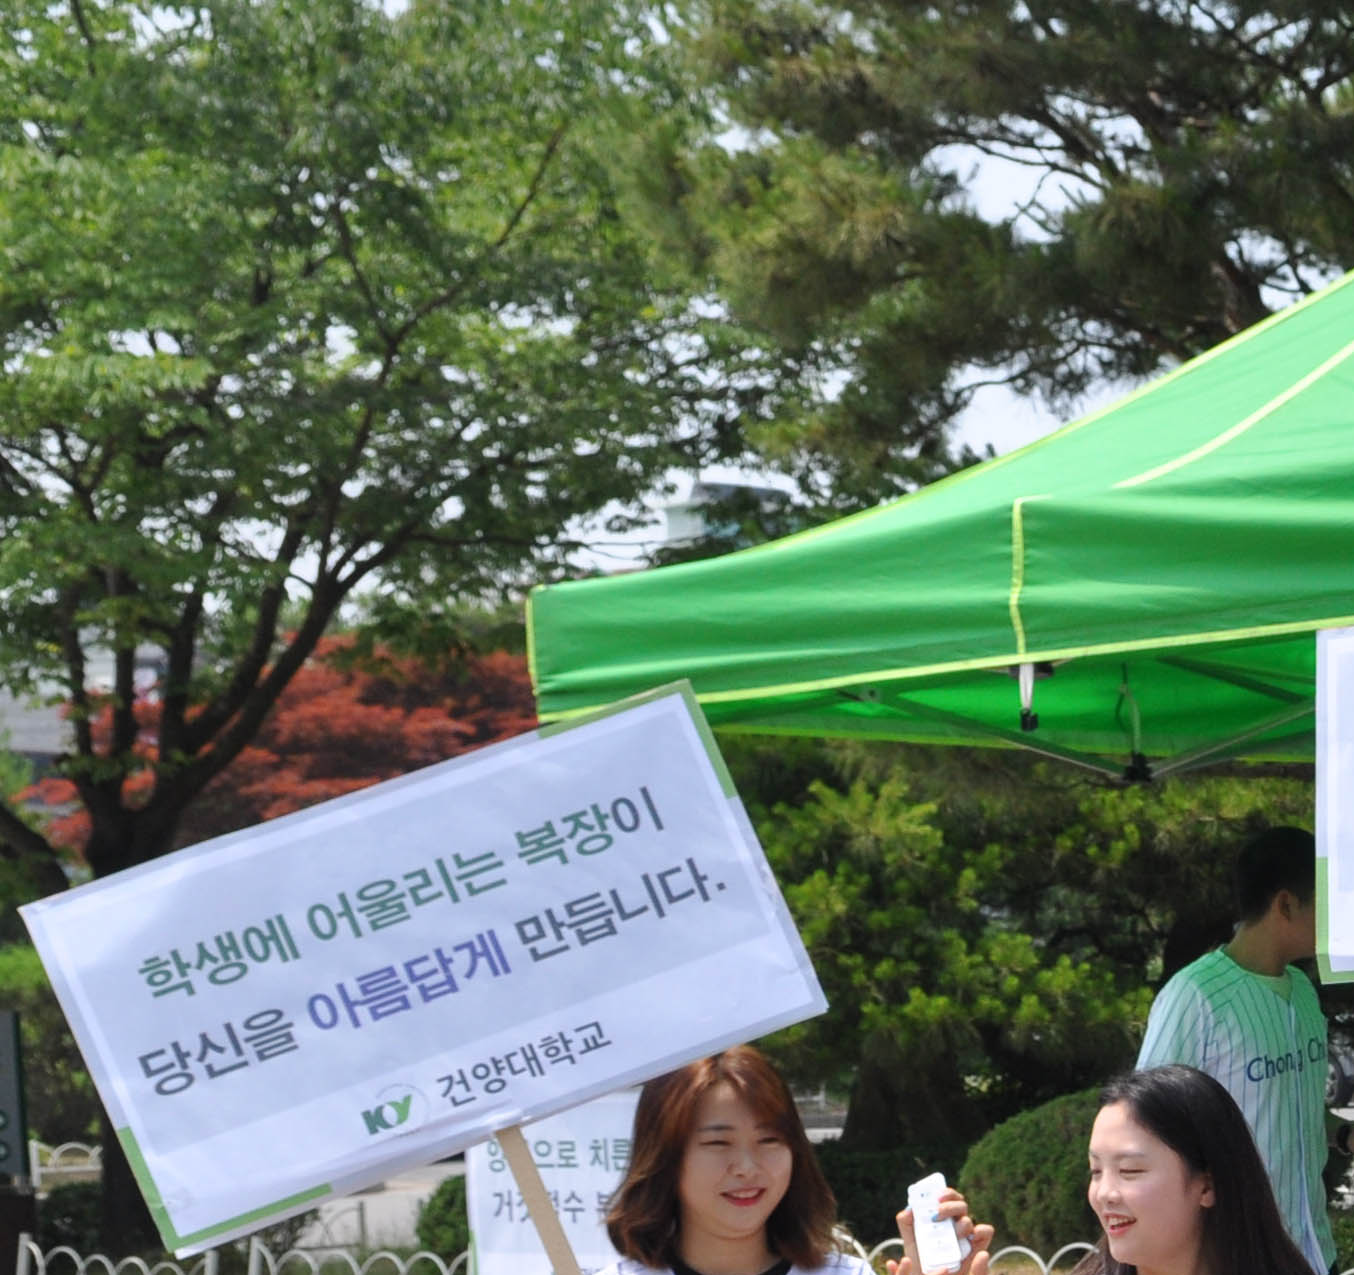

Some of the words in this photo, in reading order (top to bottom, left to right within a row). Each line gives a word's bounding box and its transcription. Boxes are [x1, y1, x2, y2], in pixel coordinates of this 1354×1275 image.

[138, 914, 301, 999] 학생에
[308, 849, 507, 942] 어울리는
[515, 787, 666, 867] 복장이
[138, 1008, 299, 1096] 당신을
[308, 929, 512, 1032] 아름답게
[515, 857, 726, 962] 만듭니다.
[437, 1021, 612, 1108] 건양대학교
